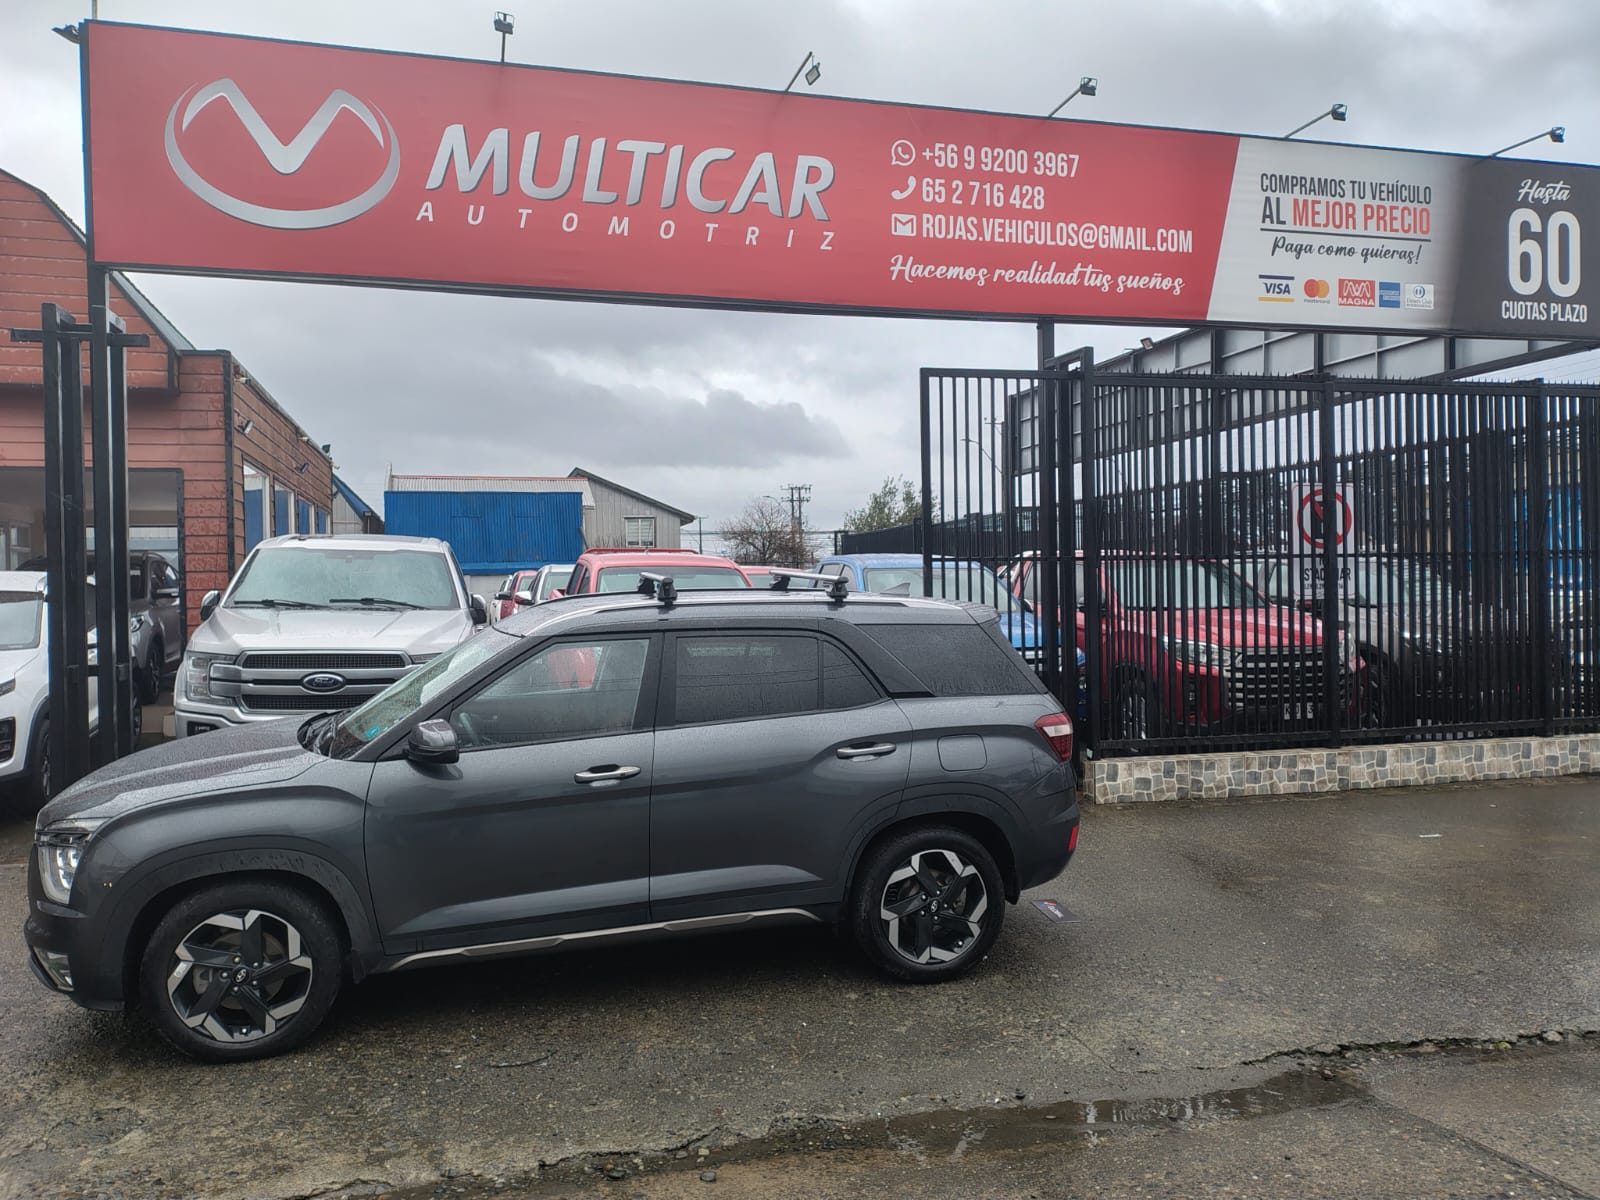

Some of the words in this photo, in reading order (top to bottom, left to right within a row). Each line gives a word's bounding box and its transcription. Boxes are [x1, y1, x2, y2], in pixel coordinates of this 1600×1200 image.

[425, 124, 835, 221] MULTICAR
[922, 143, 958, 169] +56
[963, 145, 975, 170] 9
[981, 147, 1028, 174] 9200
[1033, 150, 1080, 177] 3967
[922, 177, 946, 203] 65
[951, 180, 963, 204] 2
[968, 181, 1004, 207] 716
[1009, 184, 1045, 210] 428
[1260, 173, 1346, 199] COMPRAMOS
[1349, 180, 1366, 200] TU
[1369, 180, 1432, 205] VEHÍCULO
[1517, 179, 1571, 204] Hasta
[416, 201, 835, 250] AUTOMOTRIZ
[1261, 196, 1287, 225] AL
[1293, 198, 1357, 231] MEJOR
[1363, 203, 1431, 236] PRECIO
[922, 213, 1193, 253] ROJAS.VEHICULOS@GMAIL.COM
[1271, 236, 1315, 260] Paga
[1317, 246, 1358, 258] como
[1360, 244, 1423, 264] quieras!
[1508, 207, 1581, 298] 60
[890, 254, 990, 286] Hacemos
[992, 260, 1082, 287] realidad
[1078, 262, 1113, 293] tus
[1116, 271, 1185, 295] sueños
[1264, 282, 1291, 295] VISA
[1338, 297, 1375, 306] MAGNA
[1502, 300, 1548, 321] CUOTAS
[1550, 302, 1588, 323] PLAZO
